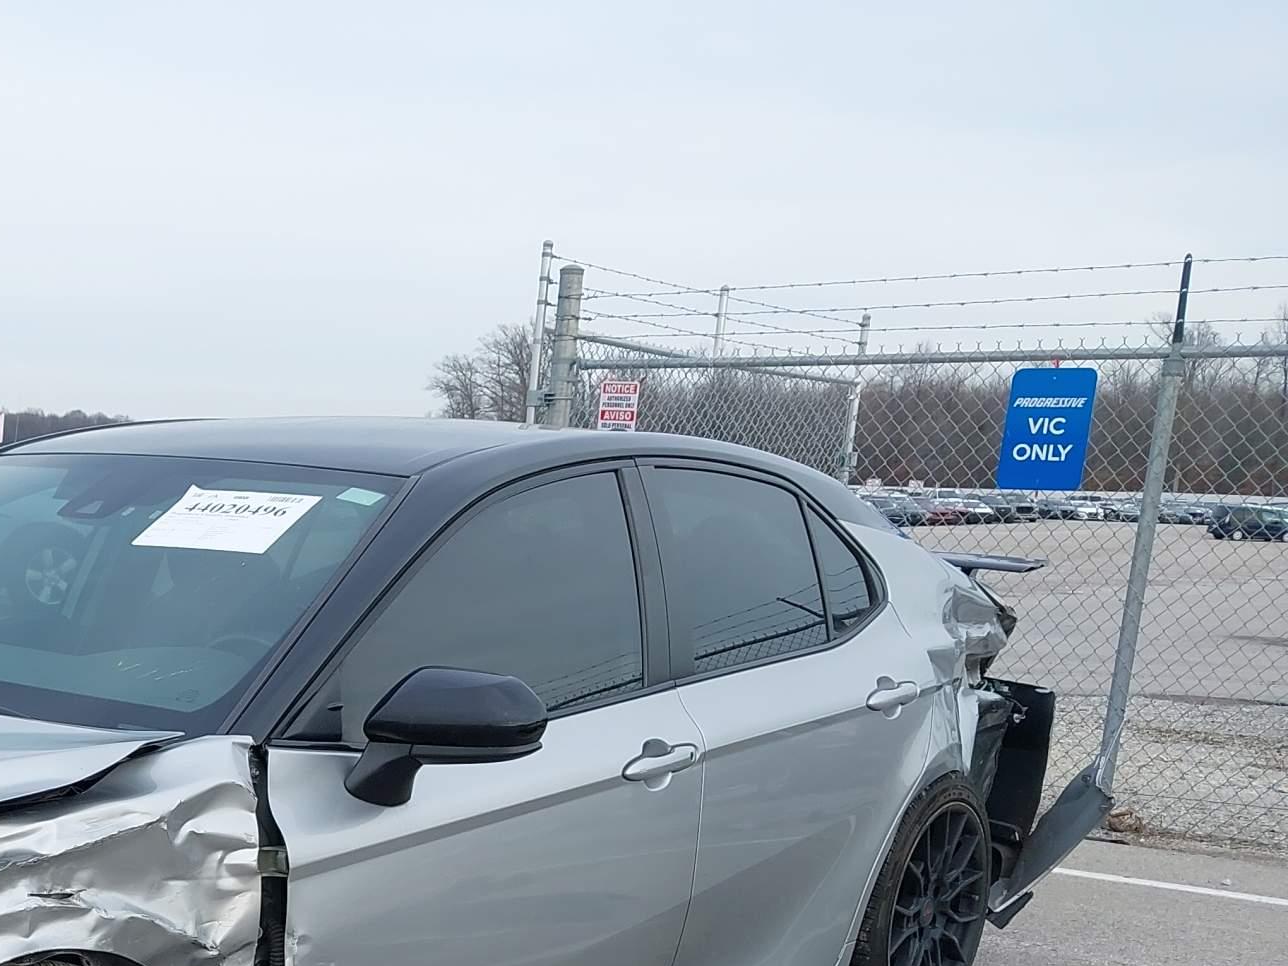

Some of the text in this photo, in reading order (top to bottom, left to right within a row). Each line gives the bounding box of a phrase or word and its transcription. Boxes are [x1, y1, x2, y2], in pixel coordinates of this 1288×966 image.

[604, 384, 637, 393] NOTICE
[1013, 397, 1087, 408] PROGRESSIVE
[602, 410, 632, 420] AVISO
[1028, 417, 1066, 435] VIC
[1012, 443, 1073, 461] ONLY
[185, 502, 289, 518] 44020496
